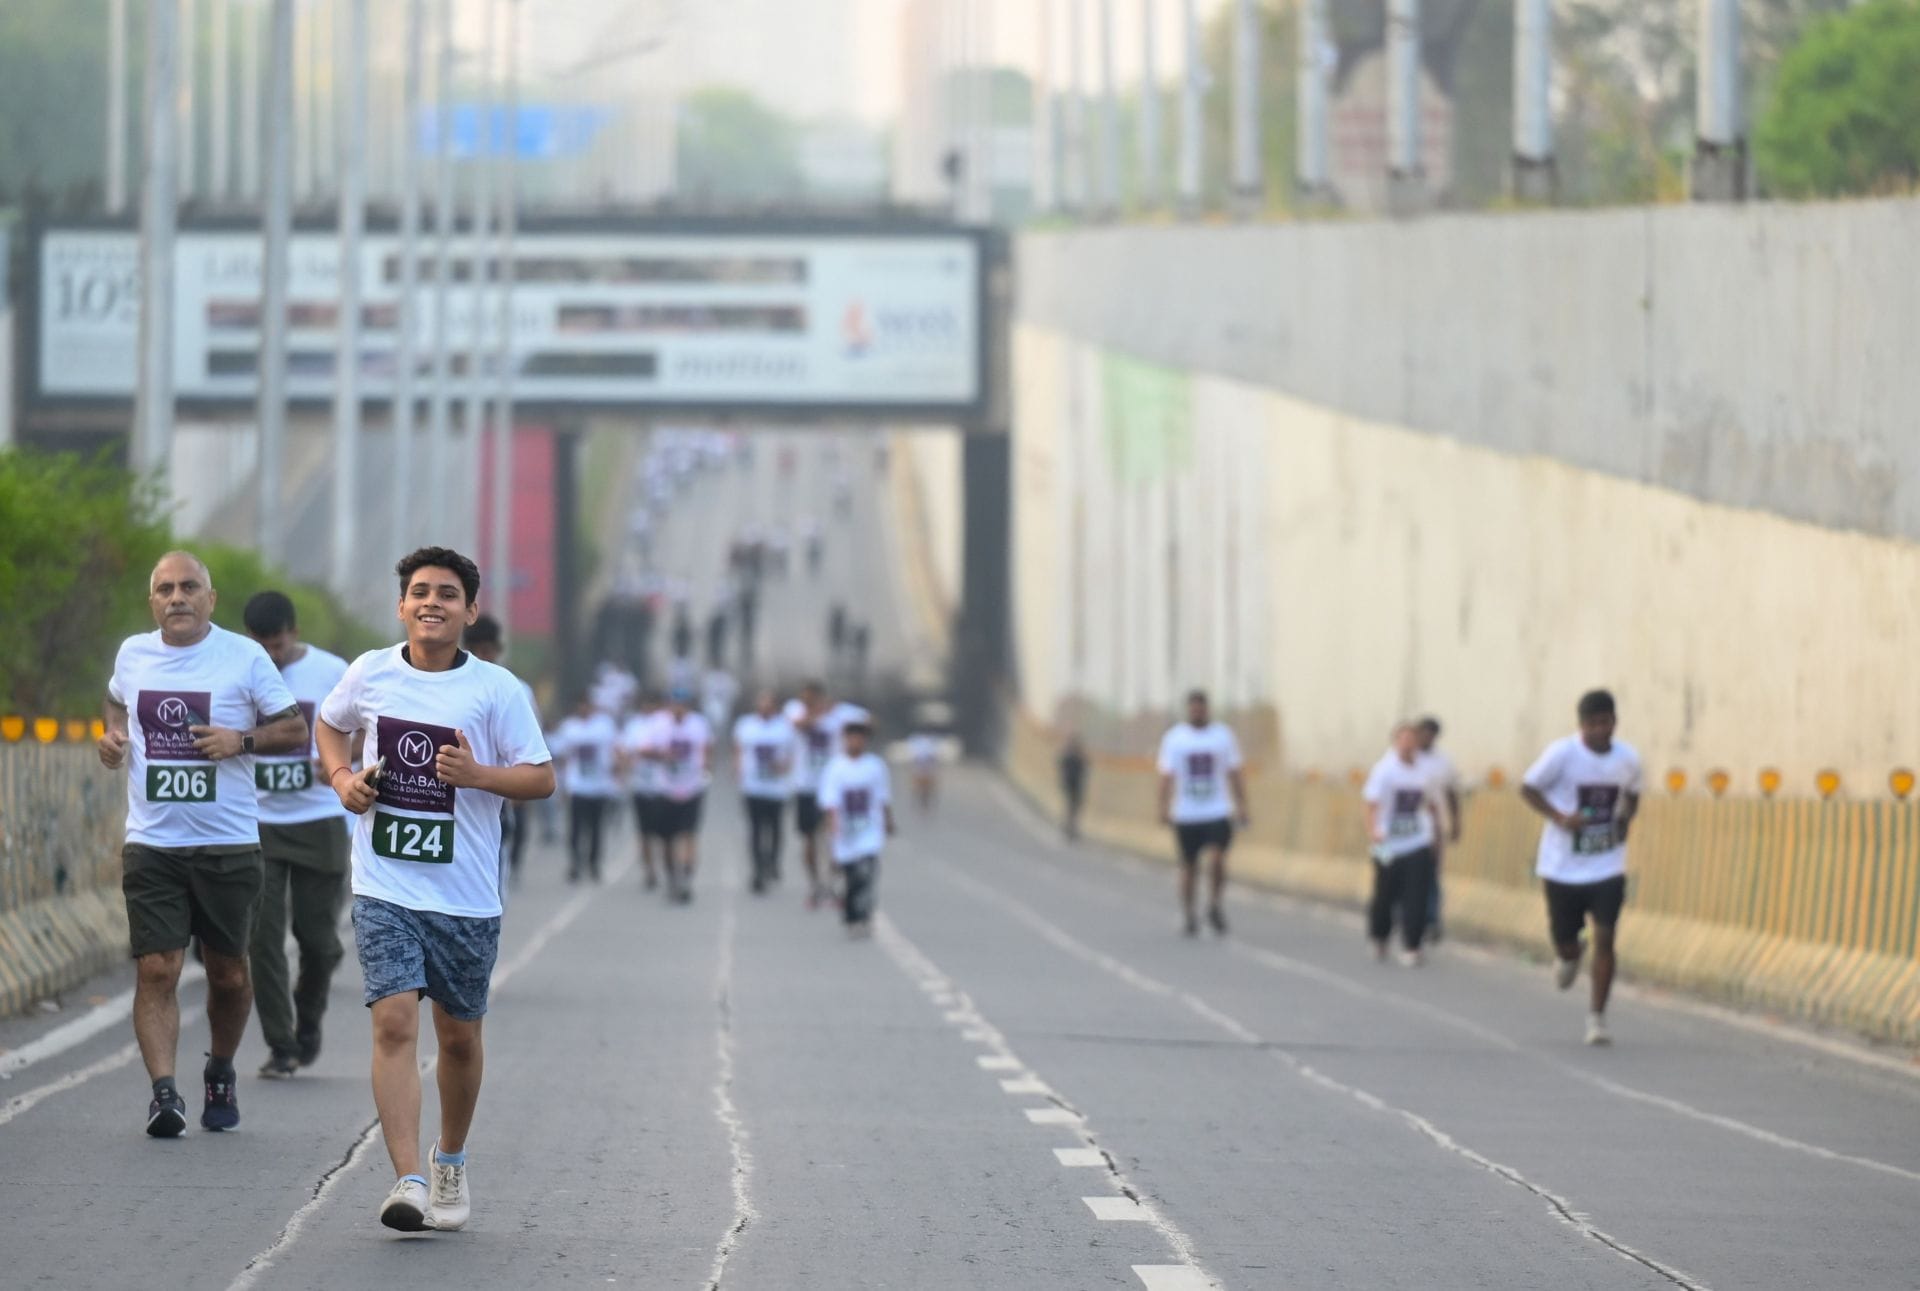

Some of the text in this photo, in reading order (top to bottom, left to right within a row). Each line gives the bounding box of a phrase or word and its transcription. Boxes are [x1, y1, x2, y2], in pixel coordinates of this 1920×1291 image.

[404, 736, 427, 761] M
[156, 769, 207, 799] 206
[263, 763, 307, 790] 126
[405, 786, 447, 799] DIAMONDS
[386, 820, 443, 858] 124
